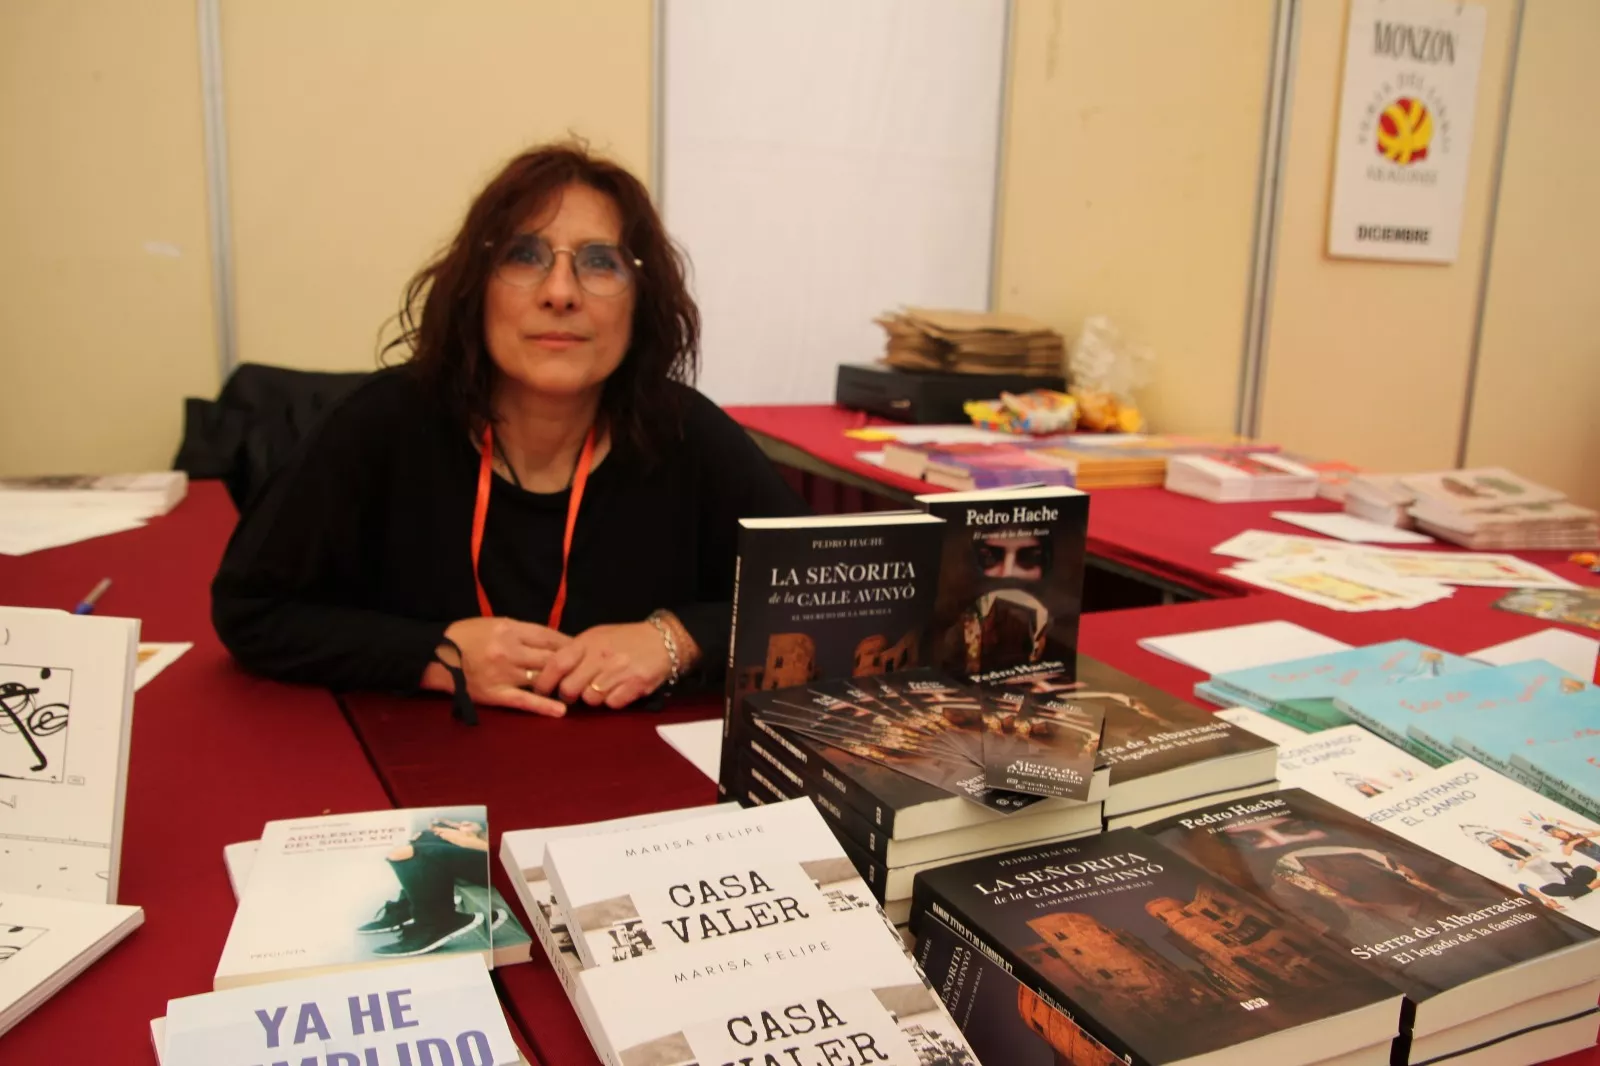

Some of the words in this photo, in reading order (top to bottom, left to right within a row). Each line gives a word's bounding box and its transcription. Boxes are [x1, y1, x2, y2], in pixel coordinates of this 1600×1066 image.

[1357, 226, 1429, 243] DICIEMBRE
[966, 508, 1010, 526] Pedro
[1012, 505, 1059, 523] Hache
[812, 539, 847, 549] PEDRO
[850, 537, 885, 547] HACHE
[771, 568, 800, 586] LA
[806, 561, 916, 584] SEÑORITA
[768, 592, 781, 604] de
[784, 591, 795, 604] la
[797, 590, 851, 607] CALLE
[854, 583, 916, 603] AVINYÓ
[1099, 744, 1126, 757] rra
[1126, 739, 1149, 751] de
[1179, 813, 1232, 830] Pedro
[1228, 798, 1287, 816] Hache
[1401, 815, 1422, 827] EL
[1422, 790, 1477, 818] CAMINO
[284, 842, 310, 850] DEL
[319, 837, 364, 846] SIGLO
[287, 826, 406, 842] ADOLESCENTES
[625, 839, 695, 857] MARISA
[705, 825, 765, 842] FELIPE
[973, 878, 1016, 895] LA
[1014, 852, 1148, 885] SEÑORITA
[999, 855, 1040, 867] PEDRO
[1040, 846, 1081, 859] HACHE
[669, 870, 775, 908] CASA
[993, 895, 1007, 905] de
[1010, 889, 1024, 900] la
[1026, 878, 1092, 899] CALLE
[1094, 862, 1164, 885] AVINYÓ
[662, 897, 809, 943] VALER
[1350, 932, 1417, 960] Sierra
[1414, 924, 1441, 940] de
[1436, 896, 1533, 932] Albarracín
[1391, 953, 1416, 965] El
[1411, 939, 1460, 956] legado
[1458, 931, 1478, 943] de
[1472, 926, 1493, 937] la
[1488, 911, 1538, 932] familia
[674, 958, 752, 983] MARISA
[764, 940, 831, 963] FELIPE
[941, 946, 963, 1004] EÑORITA
[950, 978, 963, 1016] ALLE
[254, 1002, 331, 1048] YA
[348, 988, 419, 1036] HE
[727, 998, 848, 1046] CASA
